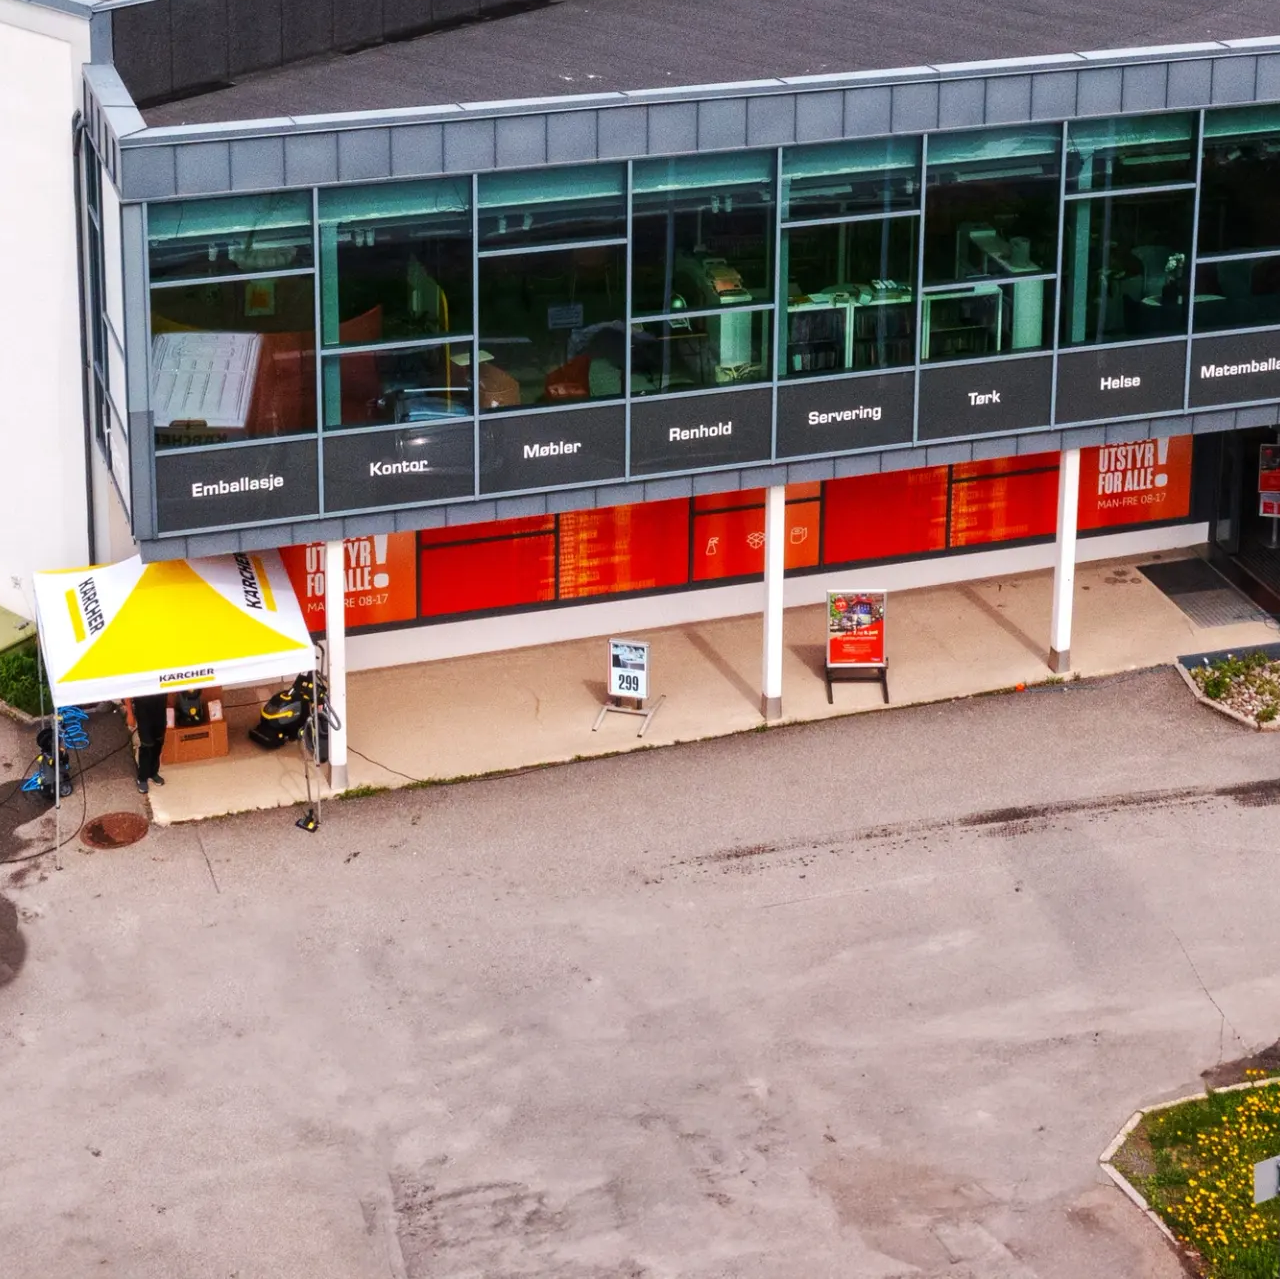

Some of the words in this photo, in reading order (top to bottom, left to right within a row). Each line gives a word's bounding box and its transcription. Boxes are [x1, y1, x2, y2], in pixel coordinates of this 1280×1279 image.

[1100, 374, 1141, 390] Helse
[968, 390, 1001, 406] Tørk
[808, 405, 882, 426] Servering
[669, 421, 732, 441] Renhold
[523, 440, 582, 459] Møbler
[1099, 442, 1155, 473] UTSTYR
[369, 458, 428, 477] Kontor
[191, 474, 284, 497] Emballasje
[1098, 471, 1122, 496] FOR
[1097, 496, 1139, 509] MAN-FRE
[1141, 493, 1166, 505] 08-17
[78, 577, 105, 636] KÄRCHER
[358, 594, 388, 606] 08-17
[160, 668, 214, 682] KÄRCHER
[618, 674, 639, 691] 299
